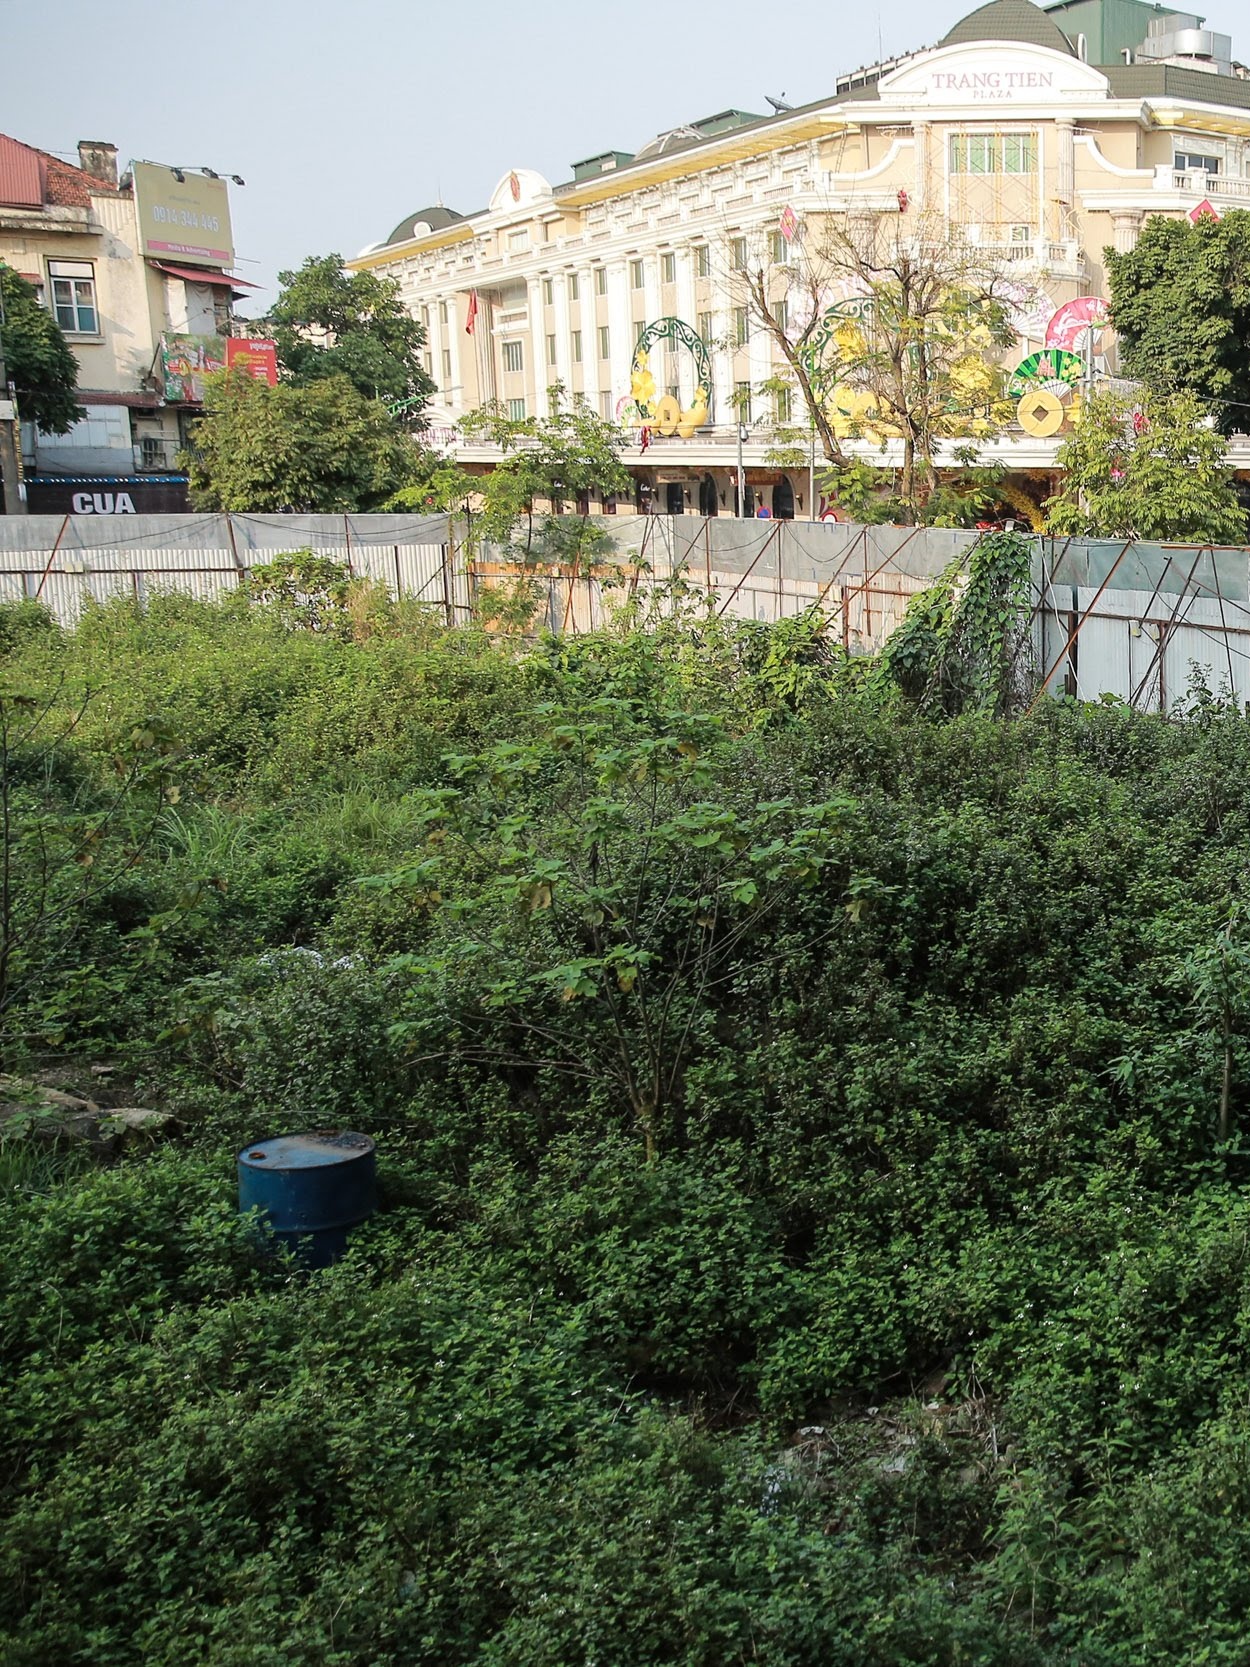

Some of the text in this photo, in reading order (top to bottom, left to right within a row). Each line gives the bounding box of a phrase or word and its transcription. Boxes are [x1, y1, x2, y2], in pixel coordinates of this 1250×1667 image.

[932, 72, 1053, 91] TRANG TIEN
[973, 90, 1012, 99] PLAZA
[153, 206, 219, 232] 0914 344 445
[72, 492, 136, 514] CUA
